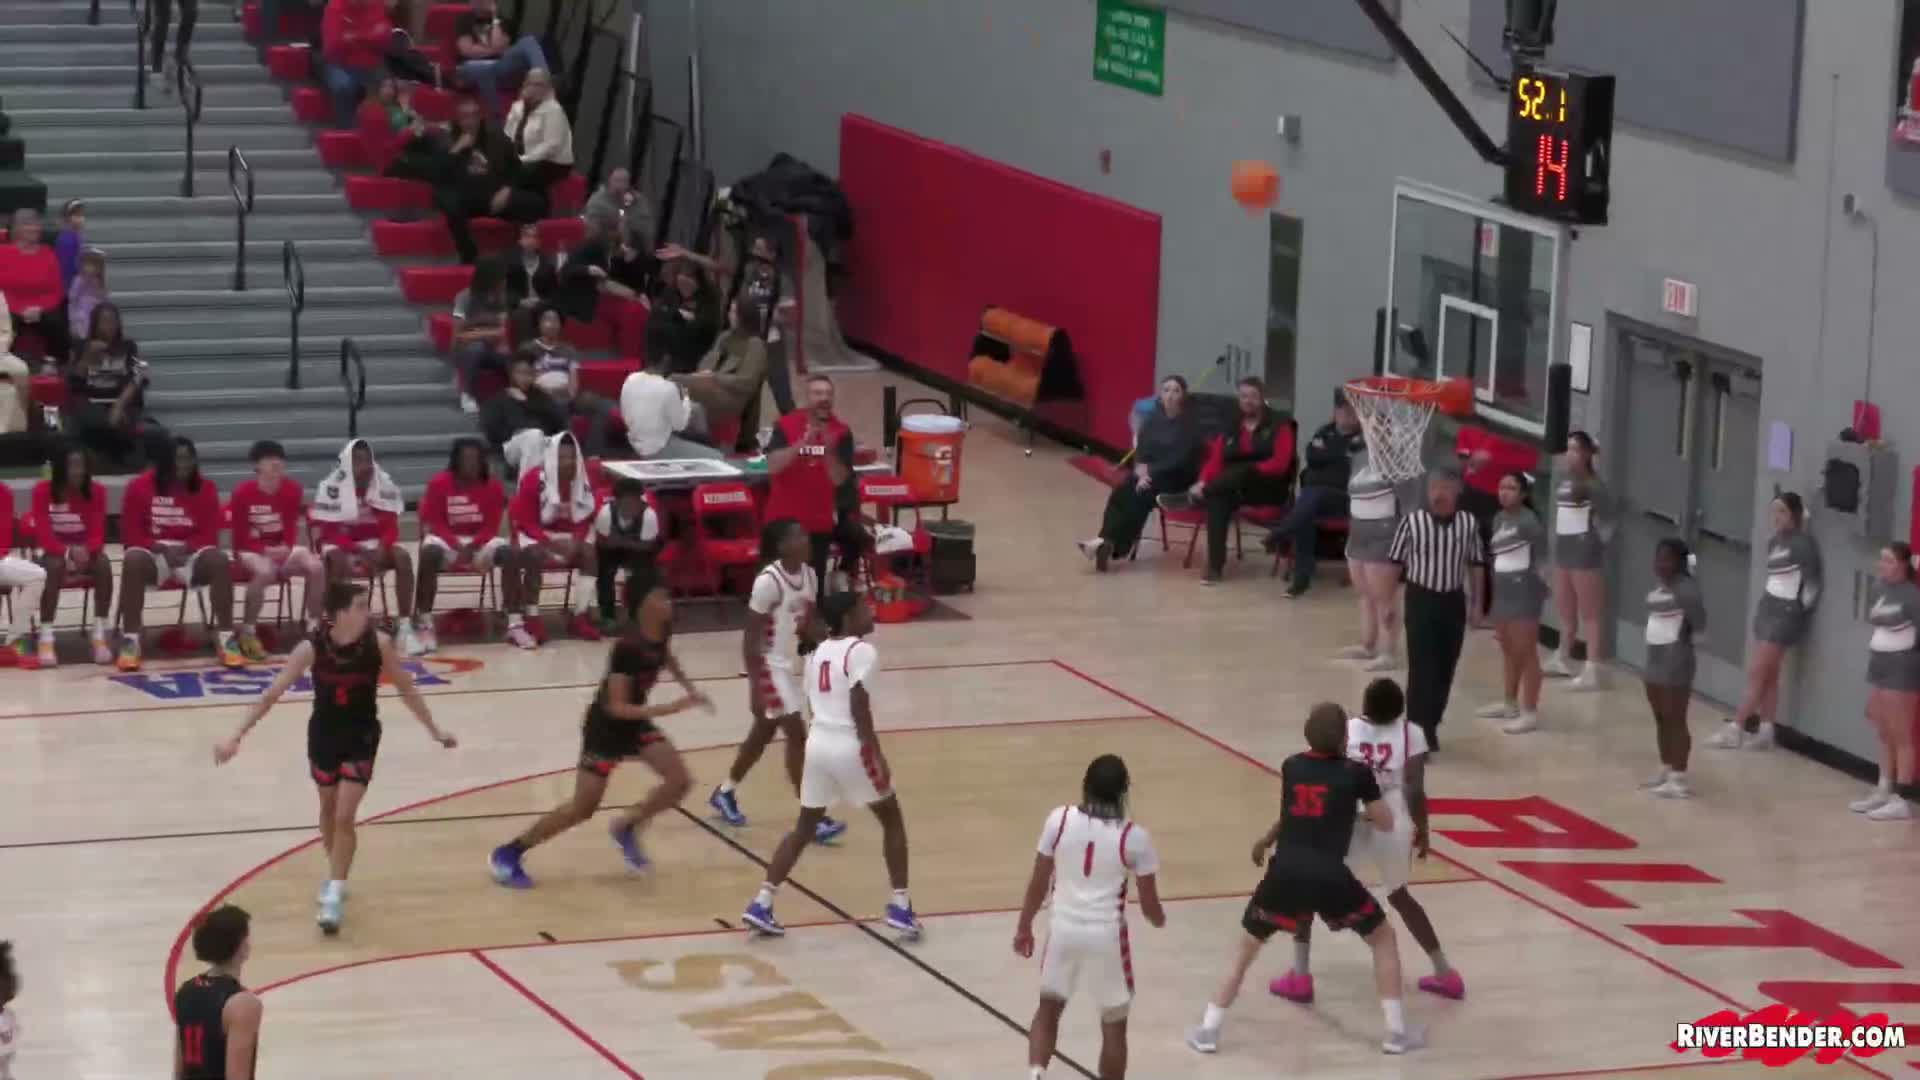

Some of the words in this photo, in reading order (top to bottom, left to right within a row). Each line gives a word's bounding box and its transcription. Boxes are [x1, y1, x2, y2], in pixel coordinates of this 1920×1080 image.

[1518, 77, 1566, 122] 52.1
[1535, 133, 1569, 201] 14
[819, 660, 832, 691] 0
[1359, 742, 1394, 772] 32
[1289, 783, 1329, 818] 35
[1083, 841, 1095, 878] 1
